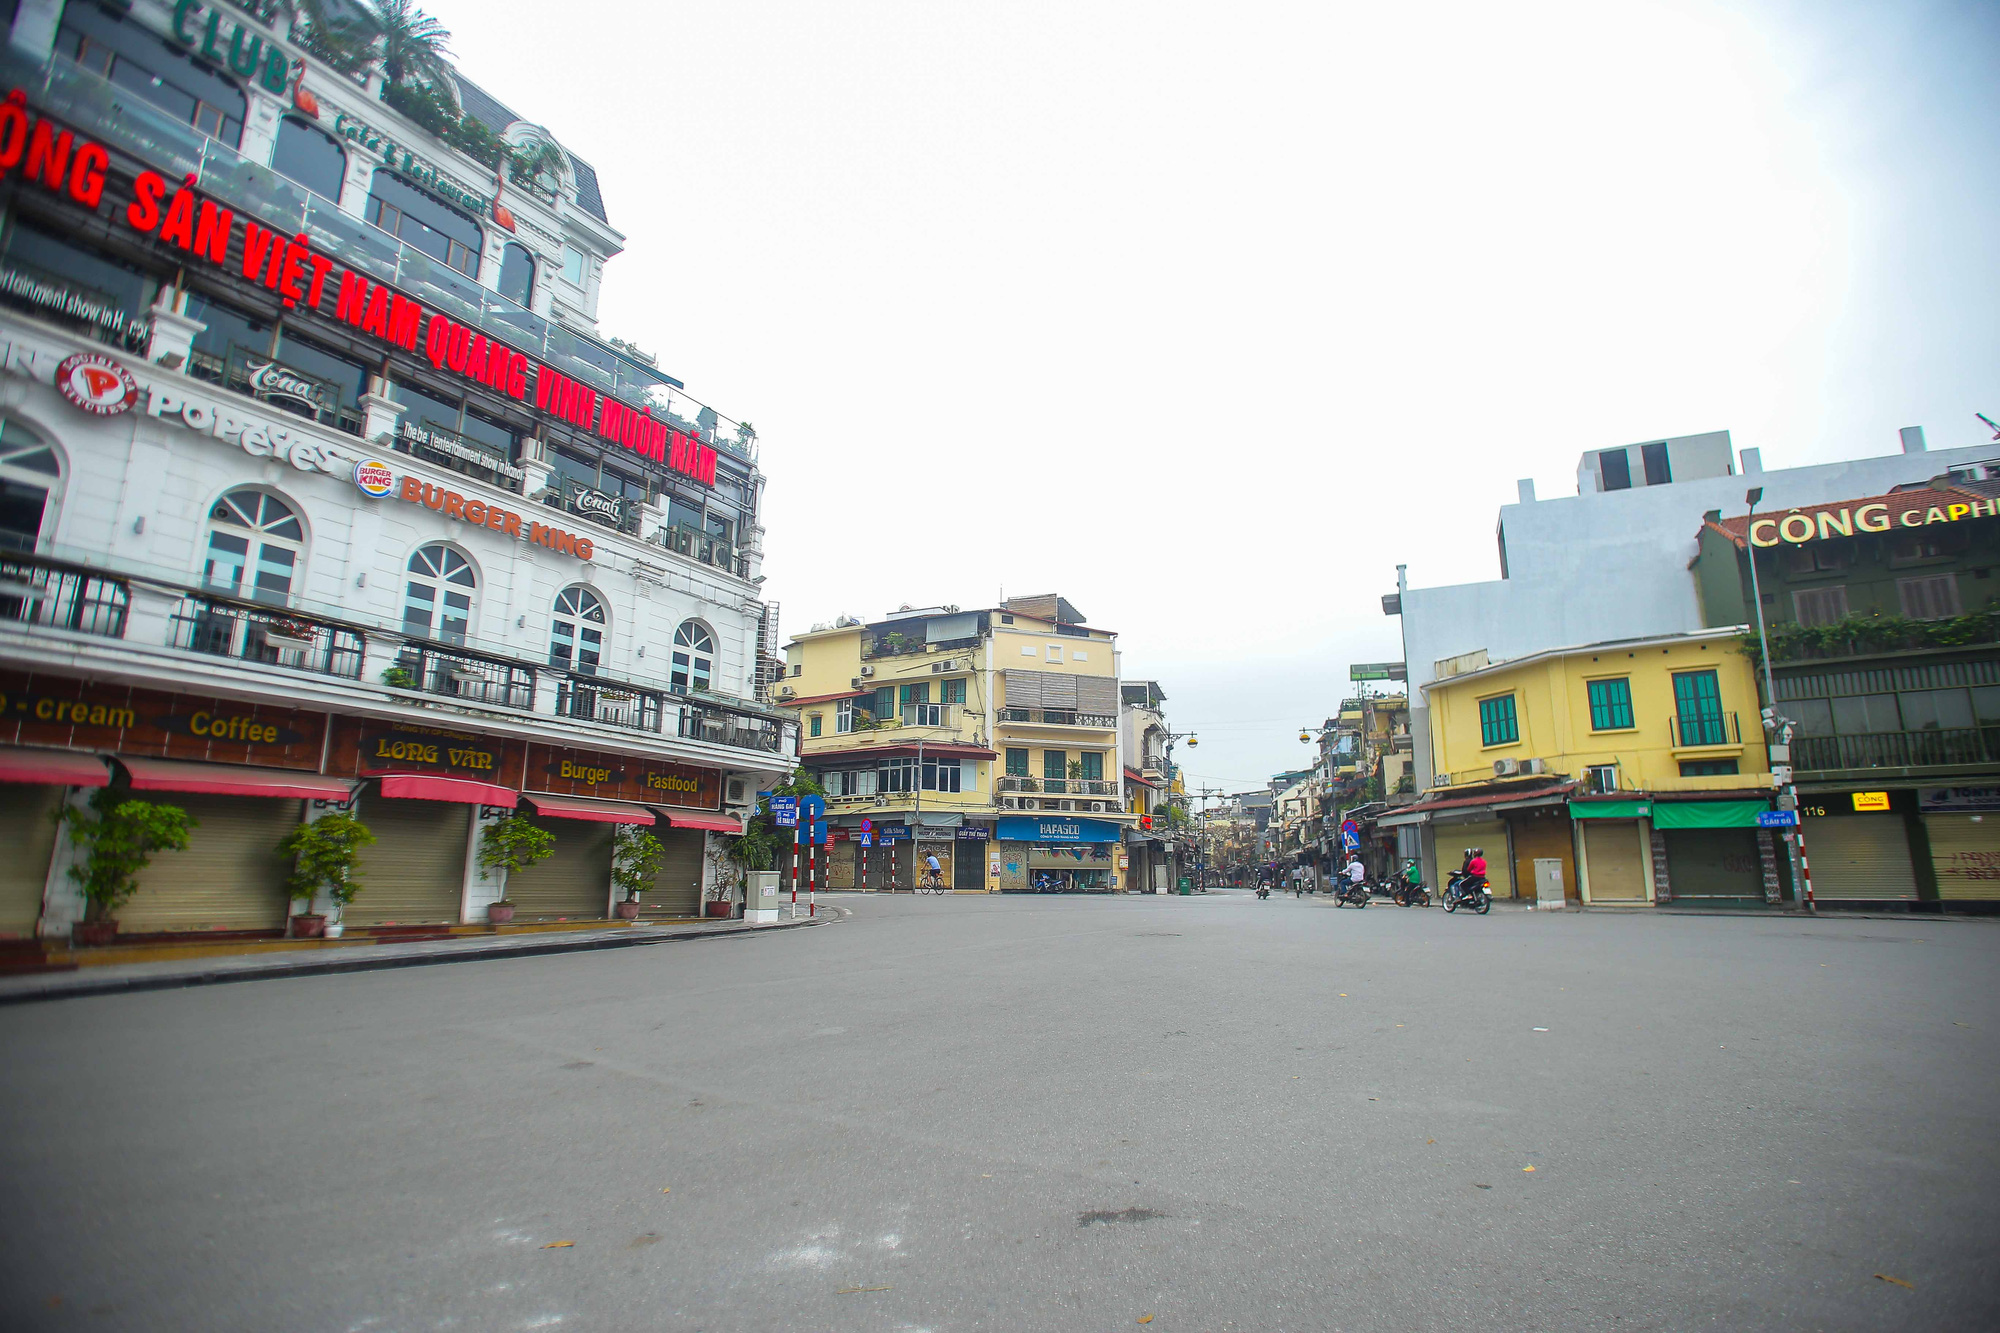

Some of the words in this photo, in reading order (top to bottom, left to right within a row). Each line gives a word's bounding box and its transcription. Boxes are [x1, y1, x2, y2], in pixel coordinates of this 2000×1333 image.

[173, 0, 288, 96] CLUB
[384, 143, 397, 166] &
[402, 151, 487, 217] Restaurant
[66, 294, 101, 322] show
[242, 221, 333, 309] VIỆT
[335, 270, 422, 351] NAM
[425, 314, 528, 400] QUANG
[536, 365, 597, 430] VINH
[599, 396, 668, 464] MUÔN
[669, 429, 718, 487] NĂM
[403, 420, 417, 440] The
[417, 426, 434, 447] bet
[434, 436, 481, 466] entertainment
[481, 452, 498, 472] show
[498, 459, 505, 474] in
[358, 475, 392, 487] KING
[359, 467, 392, 478] BURGER
[401, 475, 522, 538] BURGER
[530, 520, 594, 561] KING
[1750, 502, 1892, 549] CỘNG
[35, 697, 134, 729] cream
[190, 711, 278, 744] Coffee
[375, 739, 438, 764] LONG
[560, 760, 611, 785] Burger
[647, 771, 698, 793] Fastfood
[1803, 806, 1826, 816] 116
[883, 827, 893, 835] Silk
[1040, 823, 1080, 835] HAFASCO
